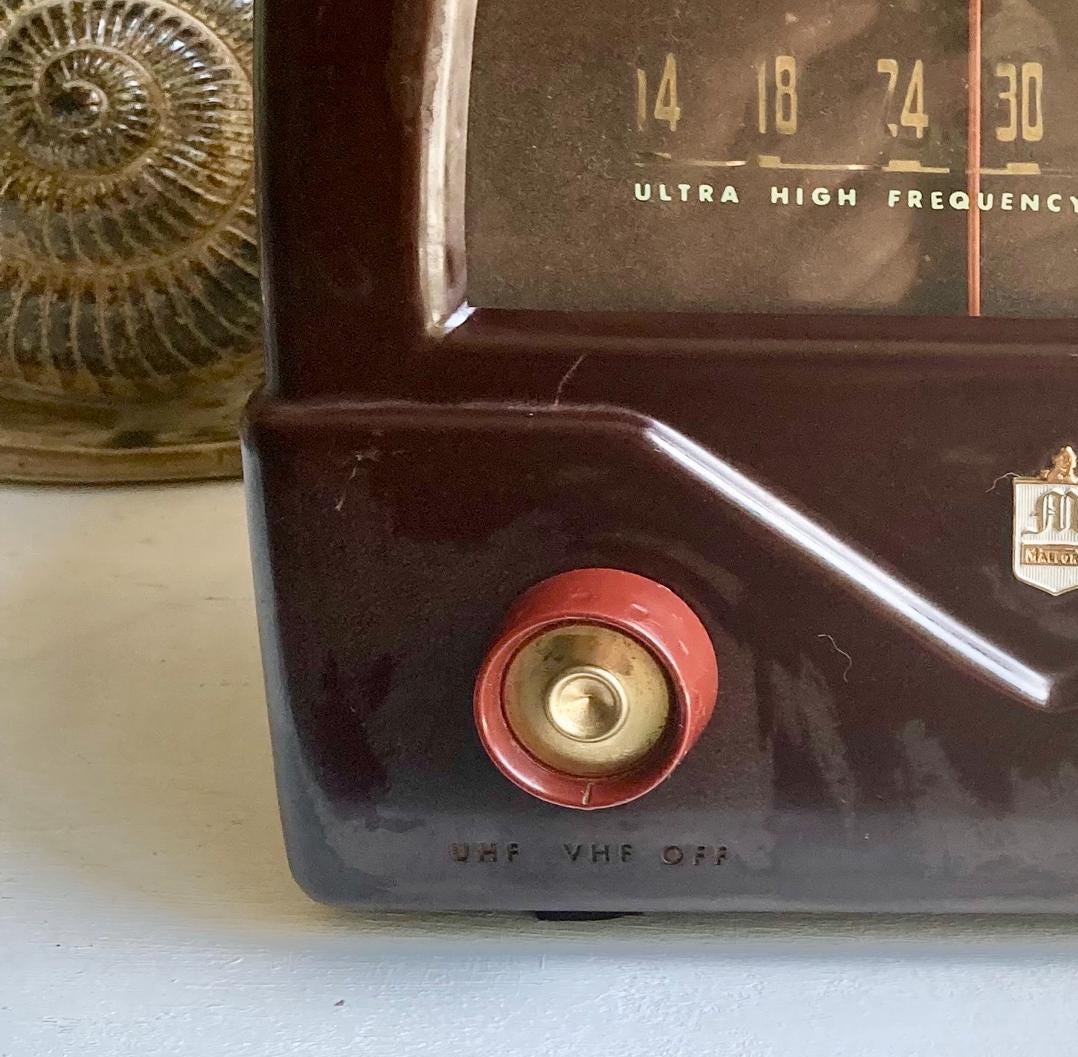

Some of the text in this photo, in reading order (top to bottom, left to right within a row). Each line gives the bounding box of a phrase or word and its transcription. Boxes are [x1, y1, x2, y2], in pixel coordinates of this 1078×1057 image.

[637, 52, 681, 132] 14
[758, 55, 797, 135] 18
[996, 62, 1043, 141] 30
[634, 183, 740, 204] ULTRA
[771, 187, 857, 206] HIGH
[450, 843, 728, 866] UHF VHF OFF
